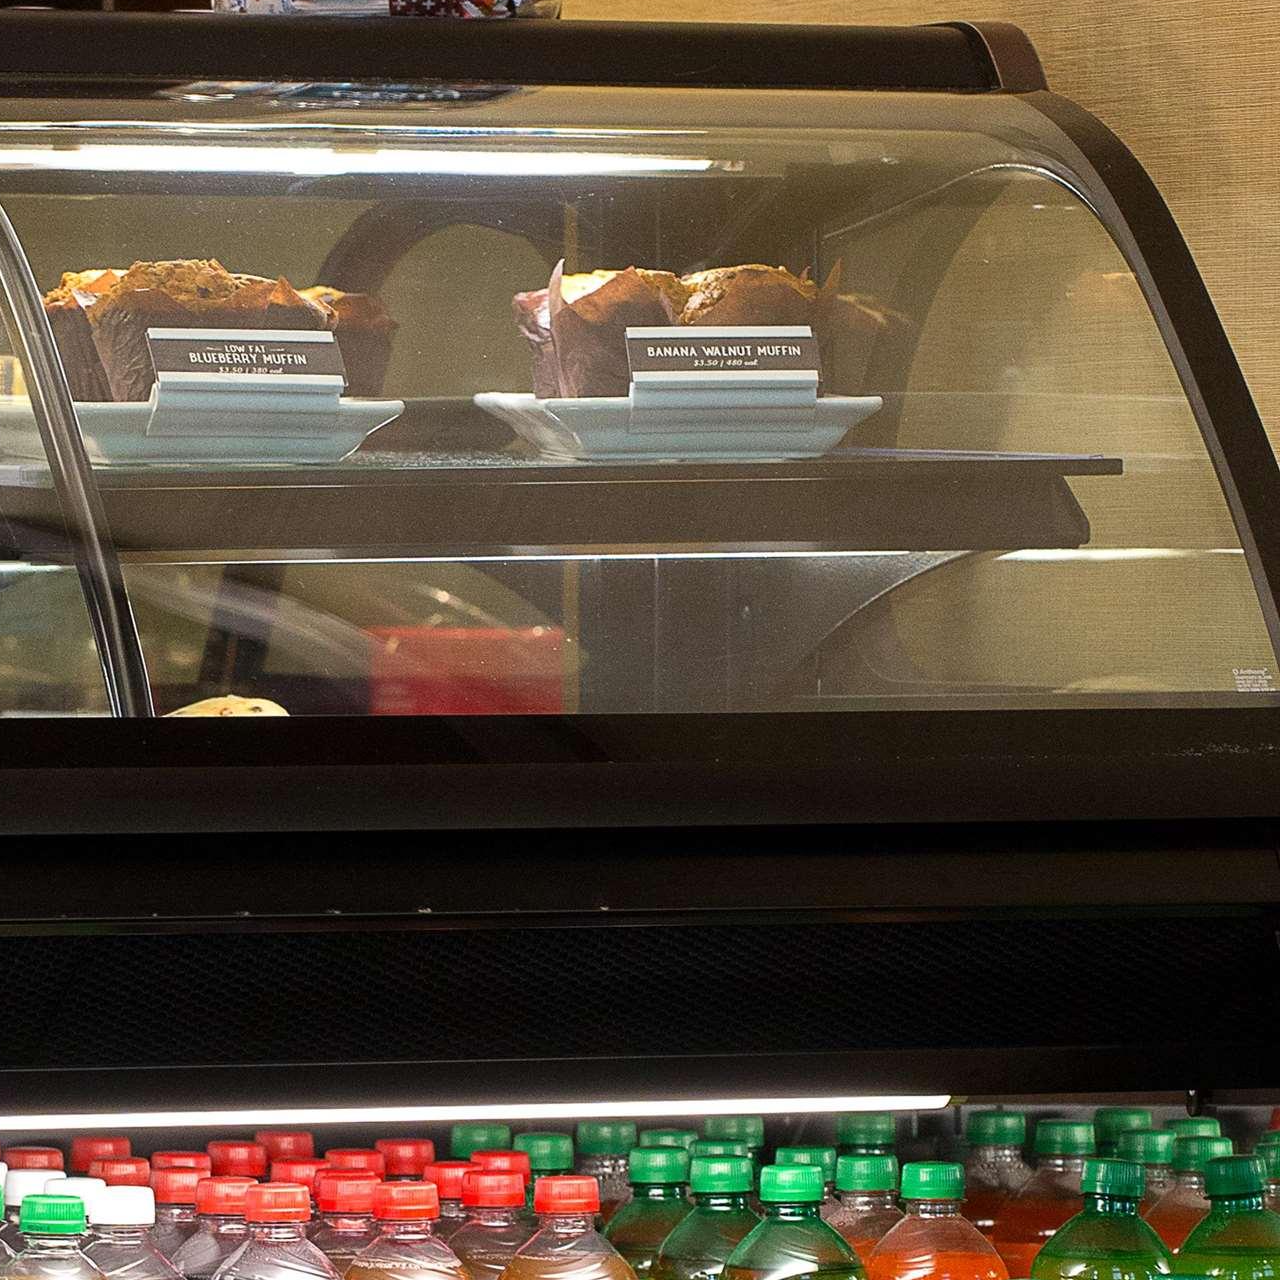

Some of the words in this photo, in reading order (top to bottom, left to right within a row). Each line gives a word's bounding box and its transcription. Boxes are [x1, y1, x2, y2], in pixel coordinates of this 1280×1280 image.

[224, 344, 246, 353] LOW
[248, 345, 266, 353] FAT
[647, 346, 698, 357] BANANA
[701, 345, 753, 357] WALNUT
[757, 345, 801, 357] MUFFIN
[188, 352, 257, 365] BLUEBERRY
[262, 354, 308, 366] MUFFIN
